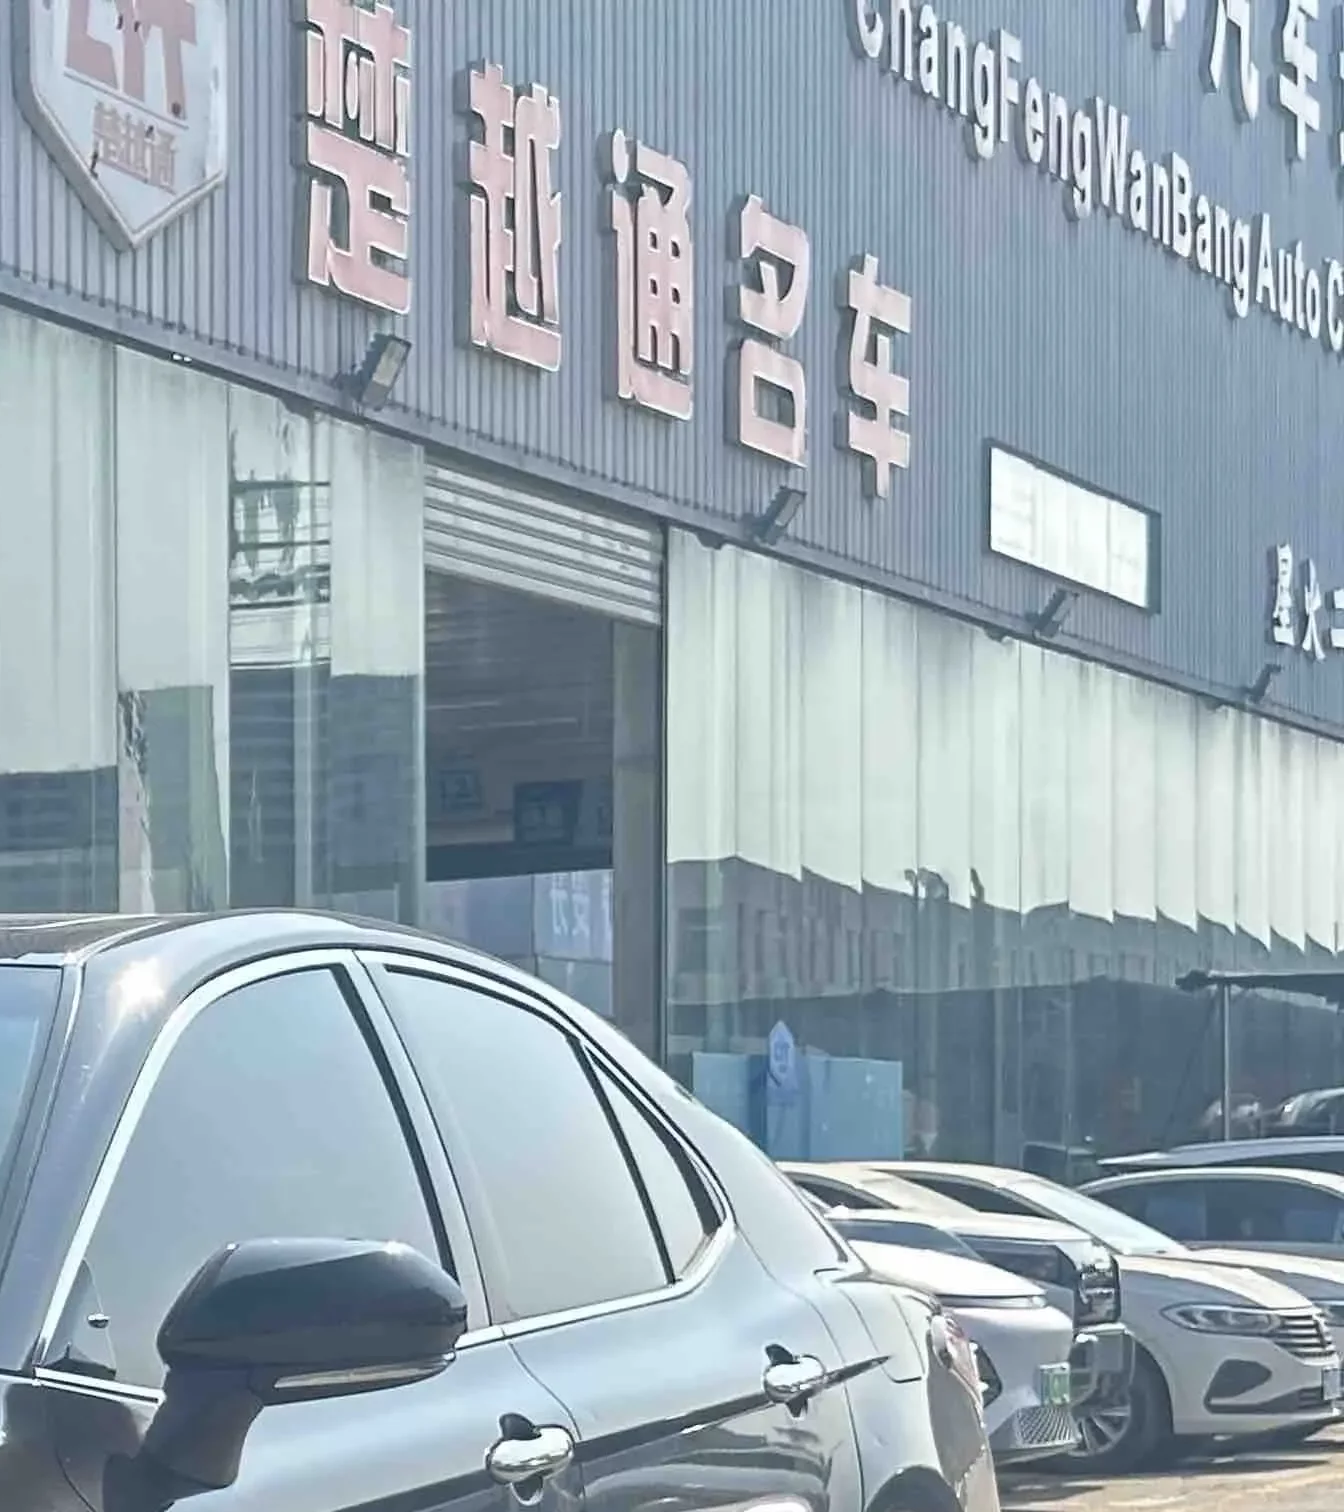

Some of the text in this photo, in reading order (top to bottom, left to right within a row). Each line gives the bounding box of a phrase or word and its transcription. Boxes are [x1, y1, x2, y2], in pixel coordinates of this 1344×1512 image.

[306, 0, 912, 498] 楚越通名车
